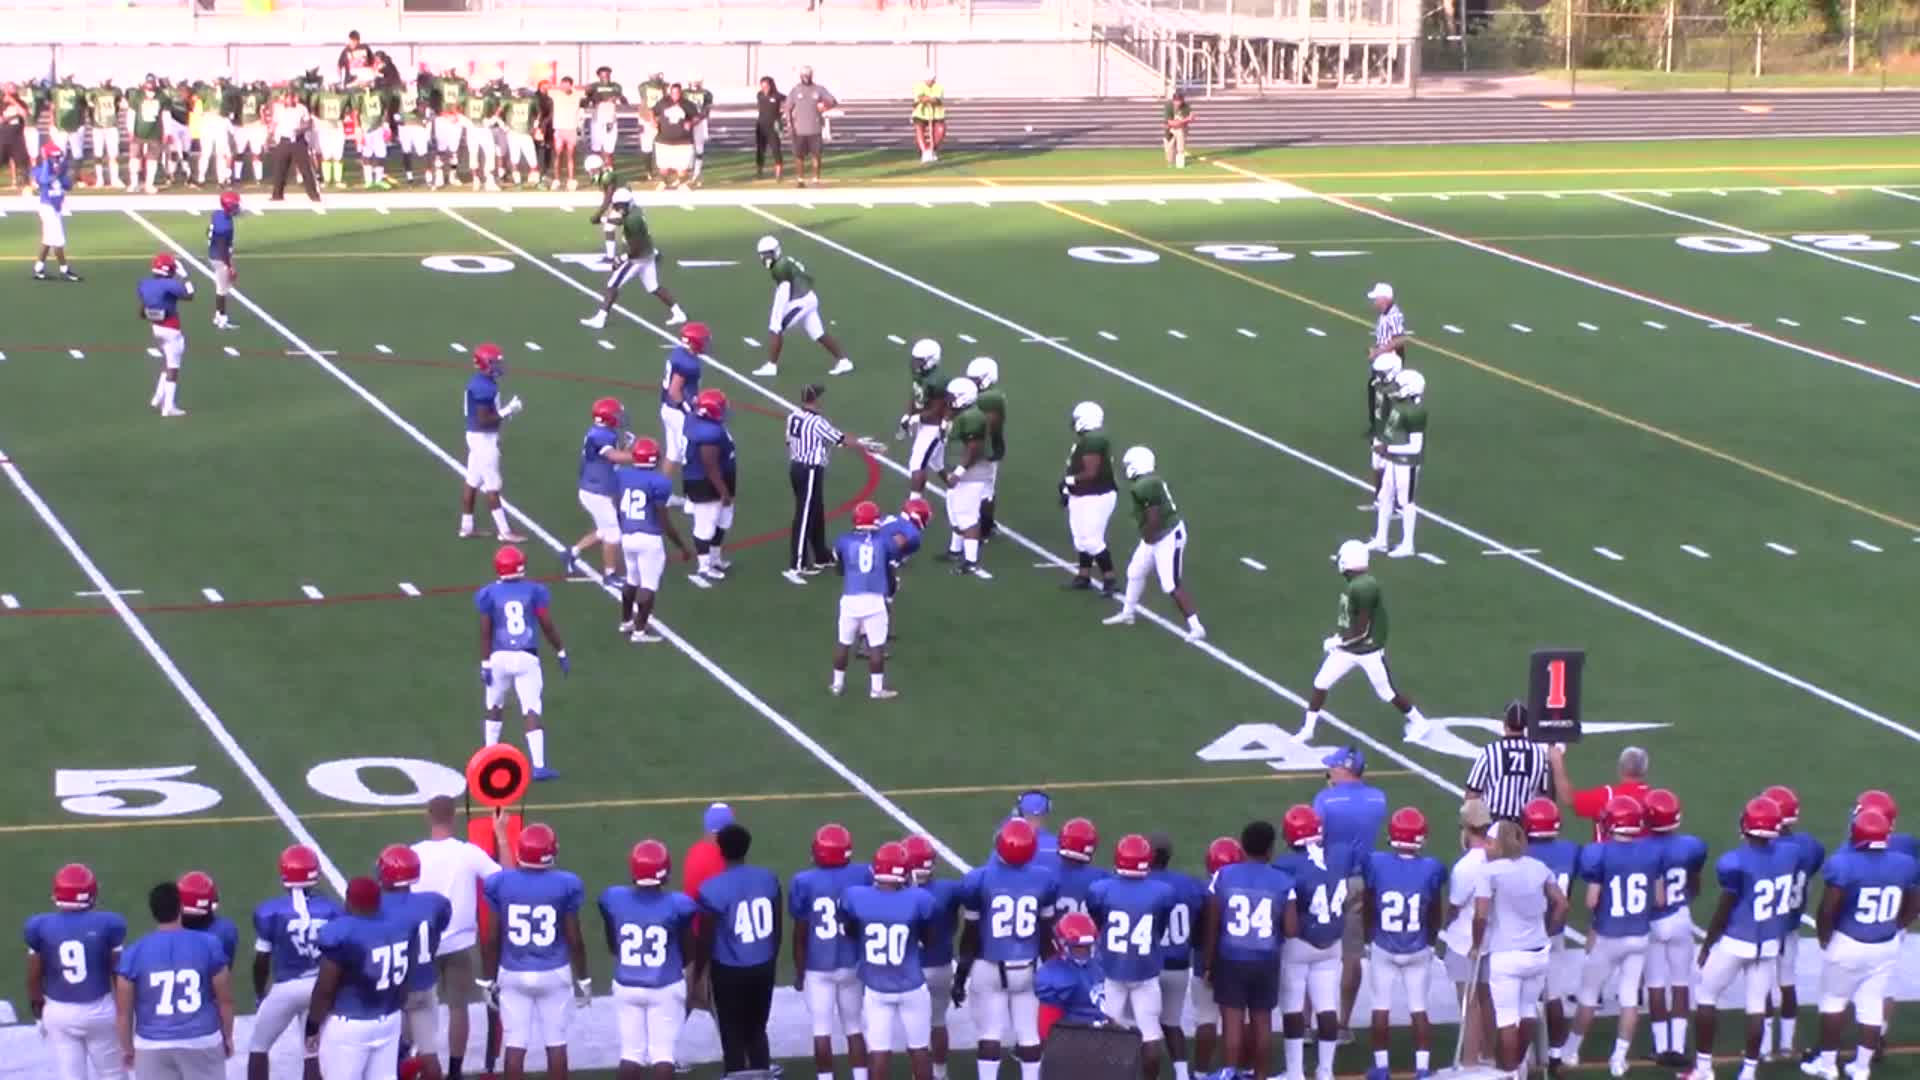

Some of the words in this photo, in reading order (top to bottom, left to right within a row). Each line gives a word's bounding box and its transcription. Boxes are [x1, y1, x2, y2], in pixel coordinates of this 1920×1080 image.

[620, 488, 647, 520] 42
[858, 542, 874, 573] 8
[503, 600, 526, 635] 8
[1546, 660, 1566, 708] 1
[1508, 752, 1526, 772] 71
[991, 895, 1038, 938] 26
[1227, 894, 1273, 938] 34
[1309, 878, 1348, 924] 44
[1381, 891, 1421, 932] 21
[1609, 873, 1647, 917] 16
[1753, 874, 1793, 921] 27
[1854, 885, 1903, 923] 50
[508, 904, 556, 946] 53
[734, 897, 773, 944] 40
[1106, 910, 1153, 955] 24
[58, 940, 87, 984] 9
[371, 940, 409, 990] 75
[620, 923, 667, 967] 23
[864, 923, 909, 966] 20
[150, 969, 202, 1015] 73
